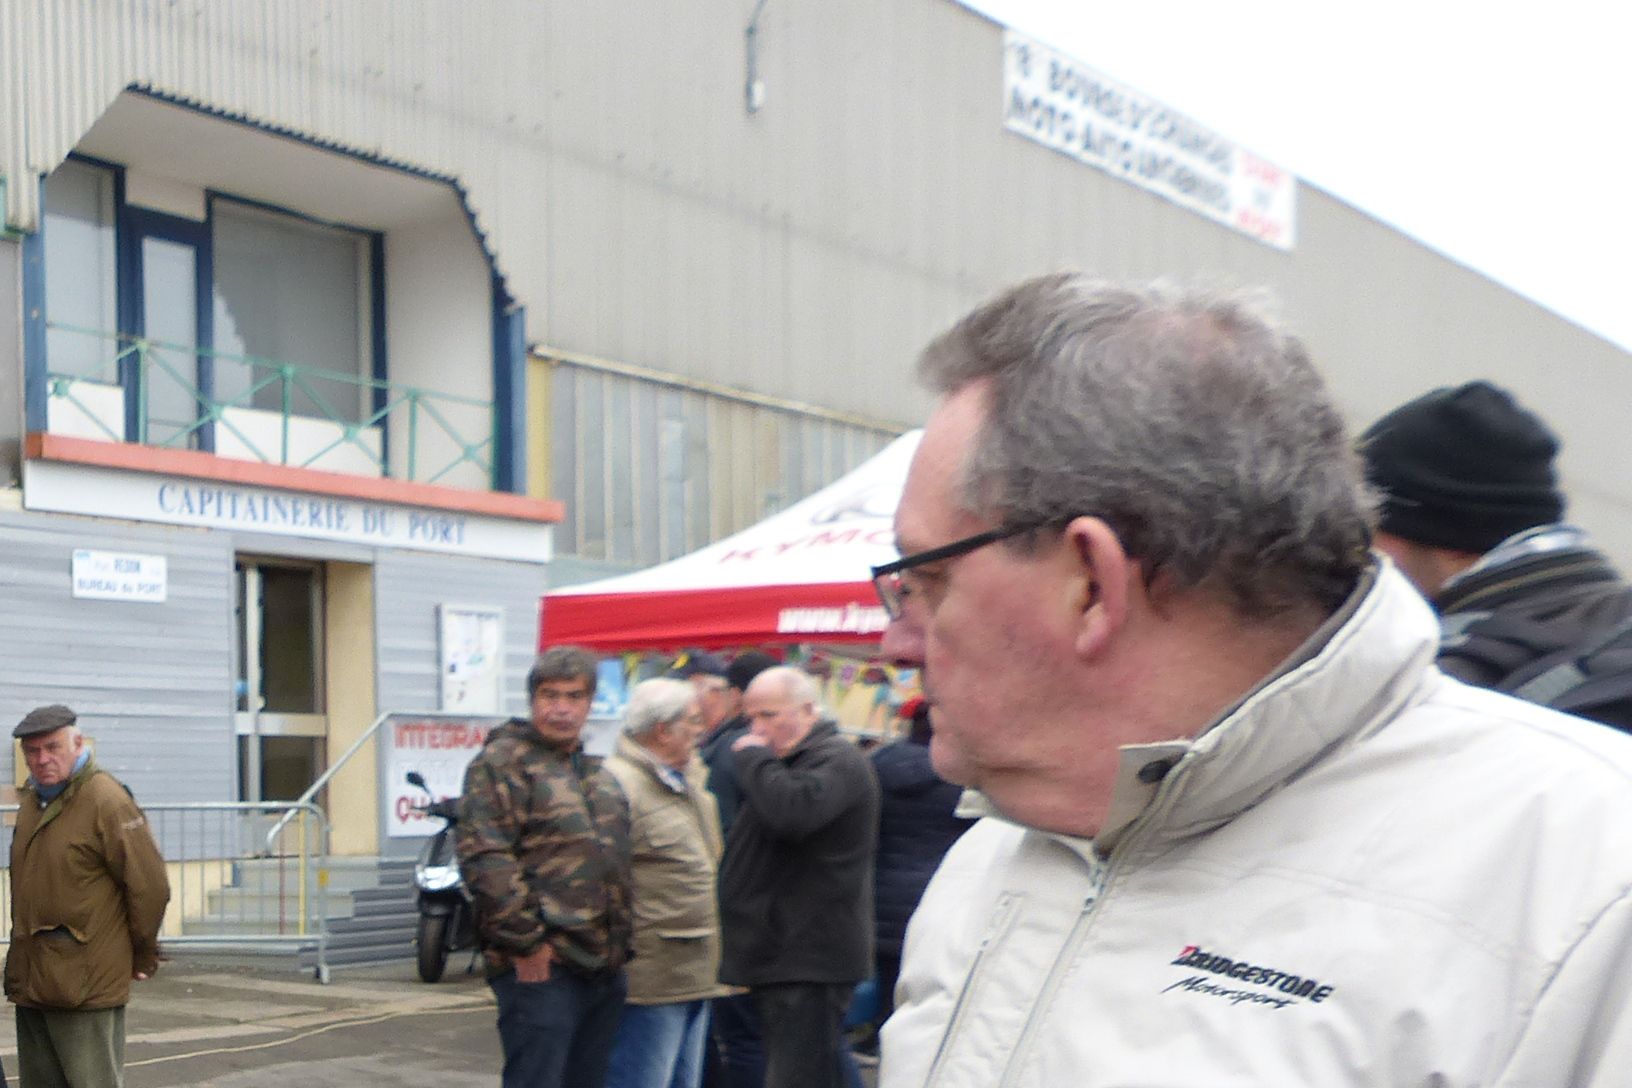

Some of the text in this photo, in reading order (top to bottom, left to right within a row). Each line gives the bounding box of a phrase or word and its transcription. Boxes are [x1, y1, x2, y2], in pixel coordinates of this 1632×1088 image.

[159, 482, 466, 546] CAPITAINERIE DU PORT
[1160, 976, 1298, 1009] Motorsport
[1170, 945, 1335, 1003] BRIDGESTONE
